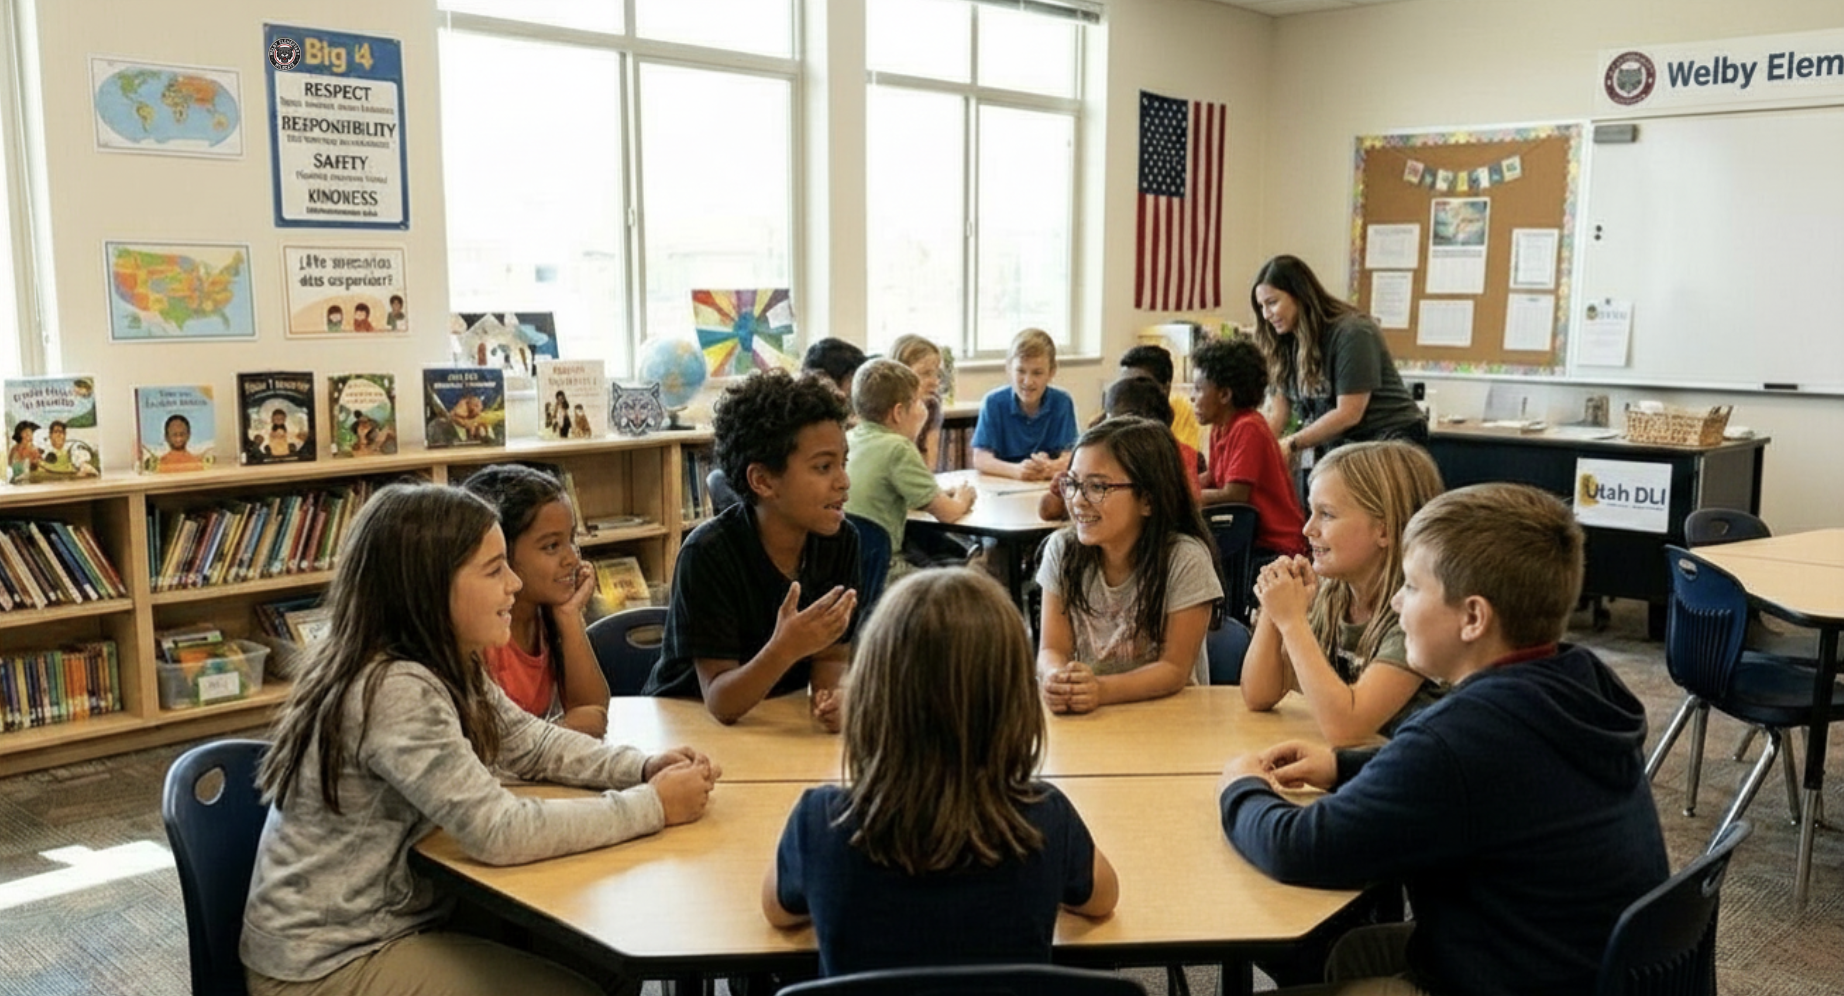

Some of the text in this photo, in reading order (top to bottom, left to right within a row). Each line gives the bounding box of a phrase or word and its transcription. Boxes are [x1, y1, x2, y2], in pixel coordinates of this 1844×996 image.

[305, 37, 347, 74] Big
[1667, 55, 1758, 90] Welby
[1767, 51, 1844, 81] Elem
[304, 82, 372, 101] RESPECT
[313, 153, 369, 170] SAFETY
[1585, 477, 1666, 505] Utah DLI
